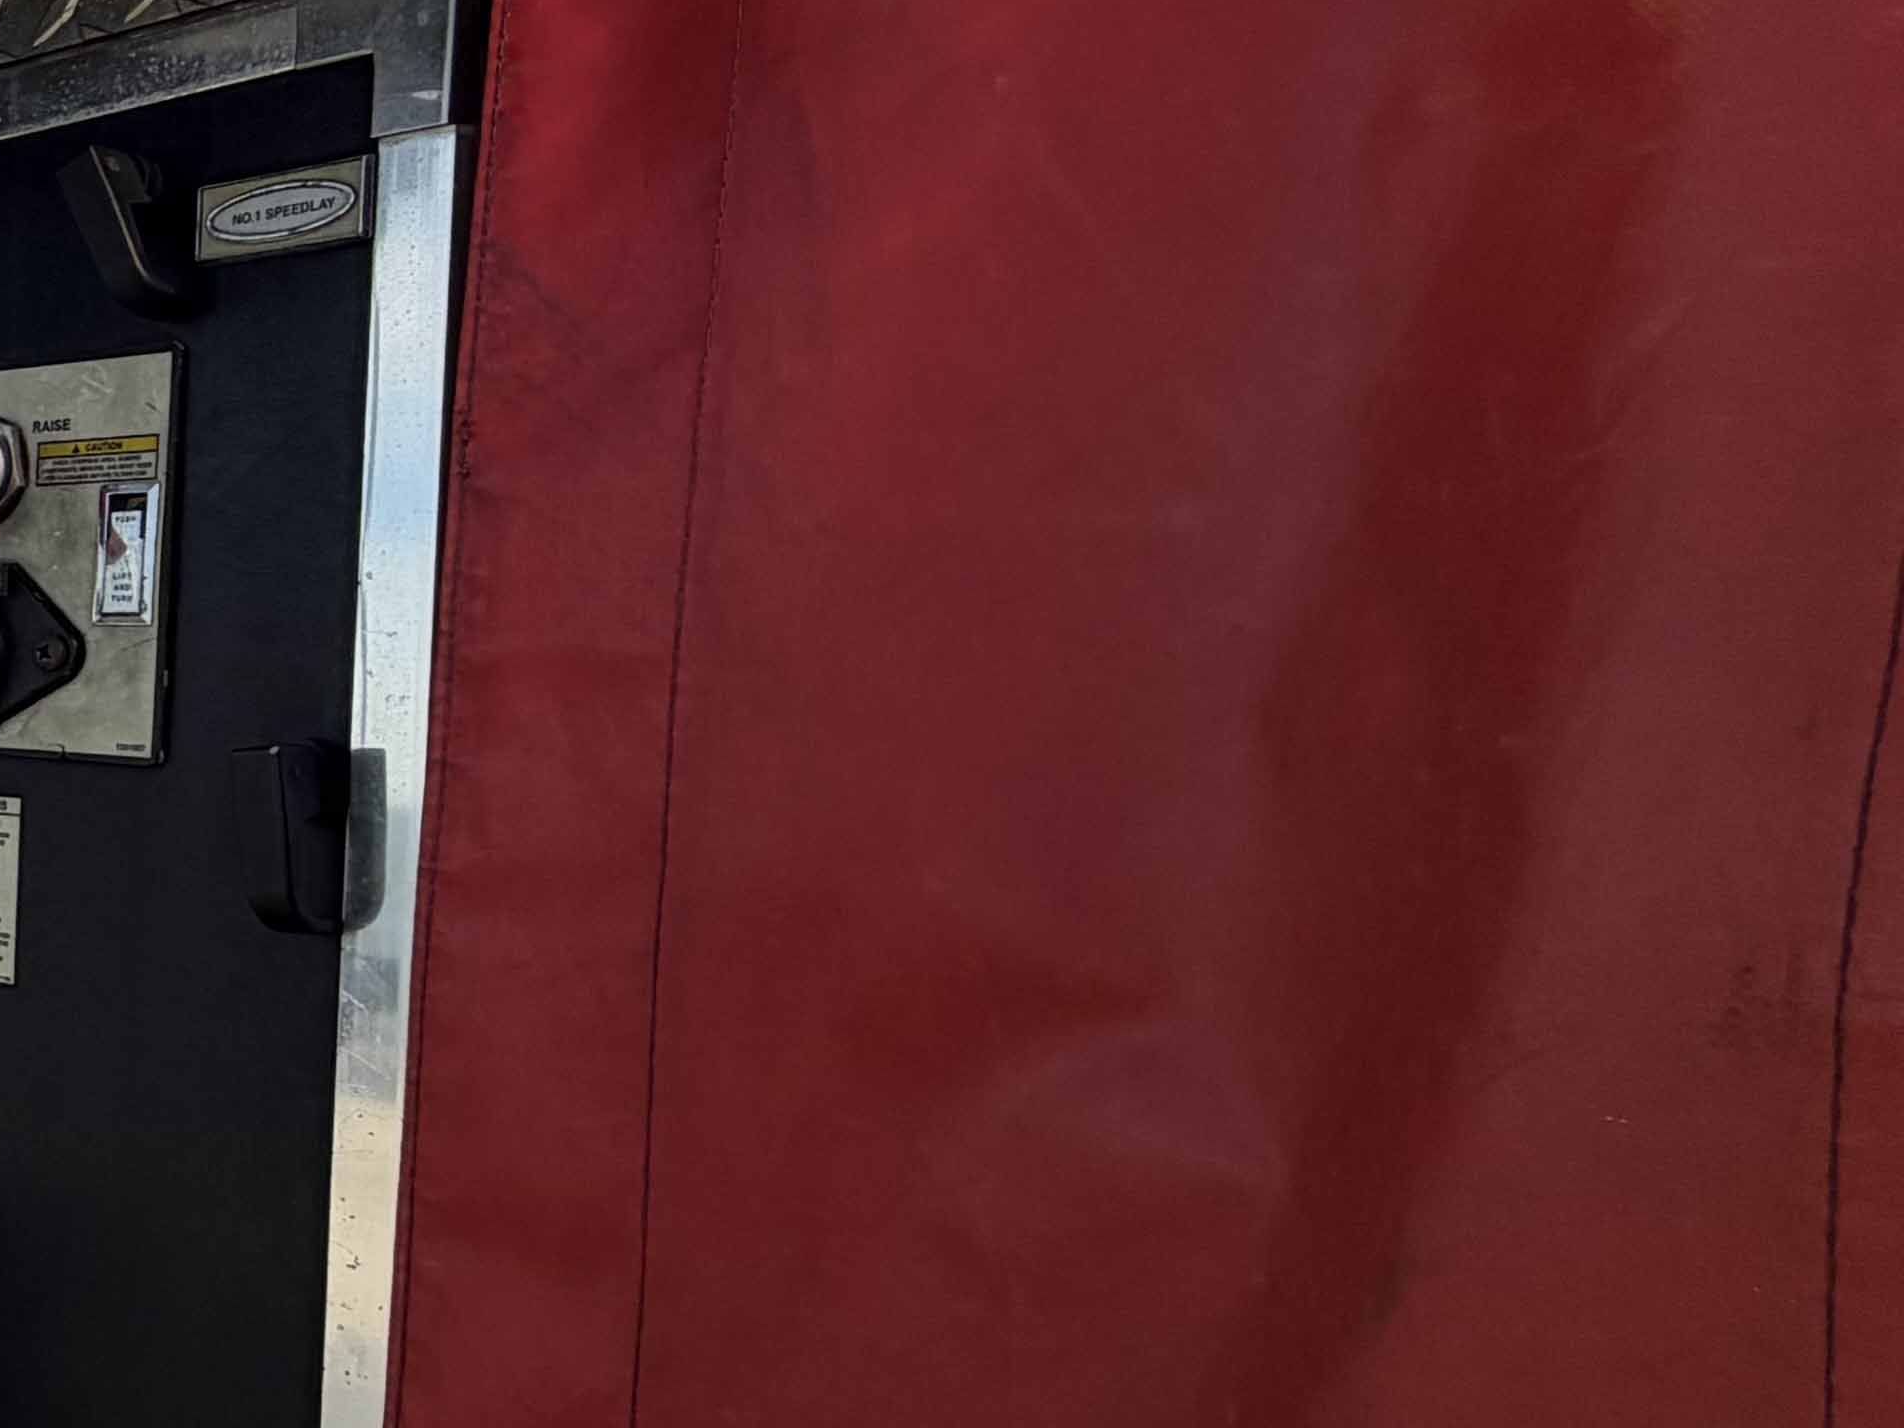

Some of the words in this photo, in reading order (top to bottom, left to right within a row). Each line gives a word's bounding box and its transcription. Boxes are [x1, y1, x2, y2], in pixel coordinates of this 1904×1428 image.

[231, 212, 261, 226] NO.1
[265, 196, 336, 221] SPEEDLAY
[32, 418, 71, 433] RAISE
[84, 441, 123, 452] CAUTION
